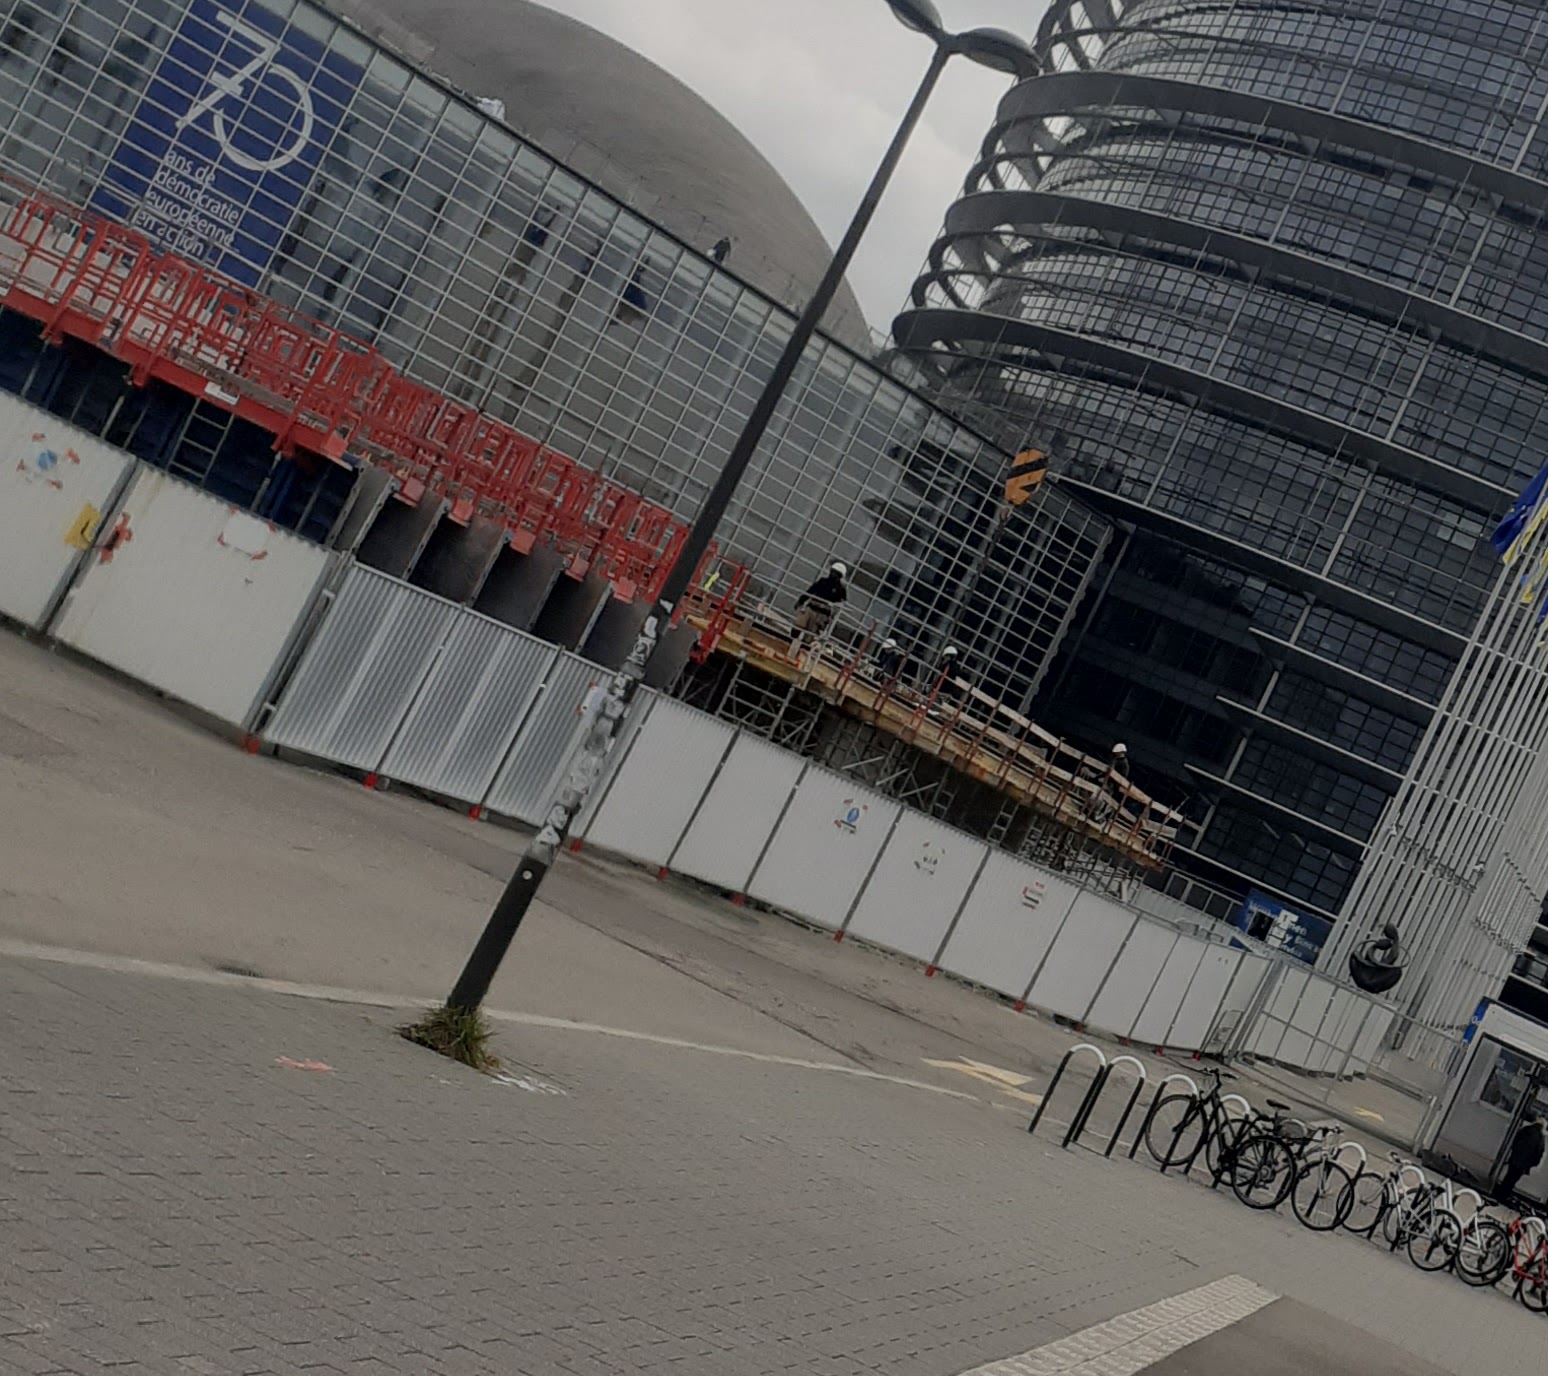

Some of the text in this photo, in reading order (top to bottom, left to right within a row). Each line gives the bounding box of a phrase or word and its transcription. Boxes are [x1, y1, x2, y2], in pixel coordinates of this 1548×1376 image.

[175, 10, 314, 171] 70
[167, 150, 216, 185] ans de
[138, 212, 156, 230] en
[147, 190, 234, 246] européenne
[156, 169, 239, 223] démocratie
